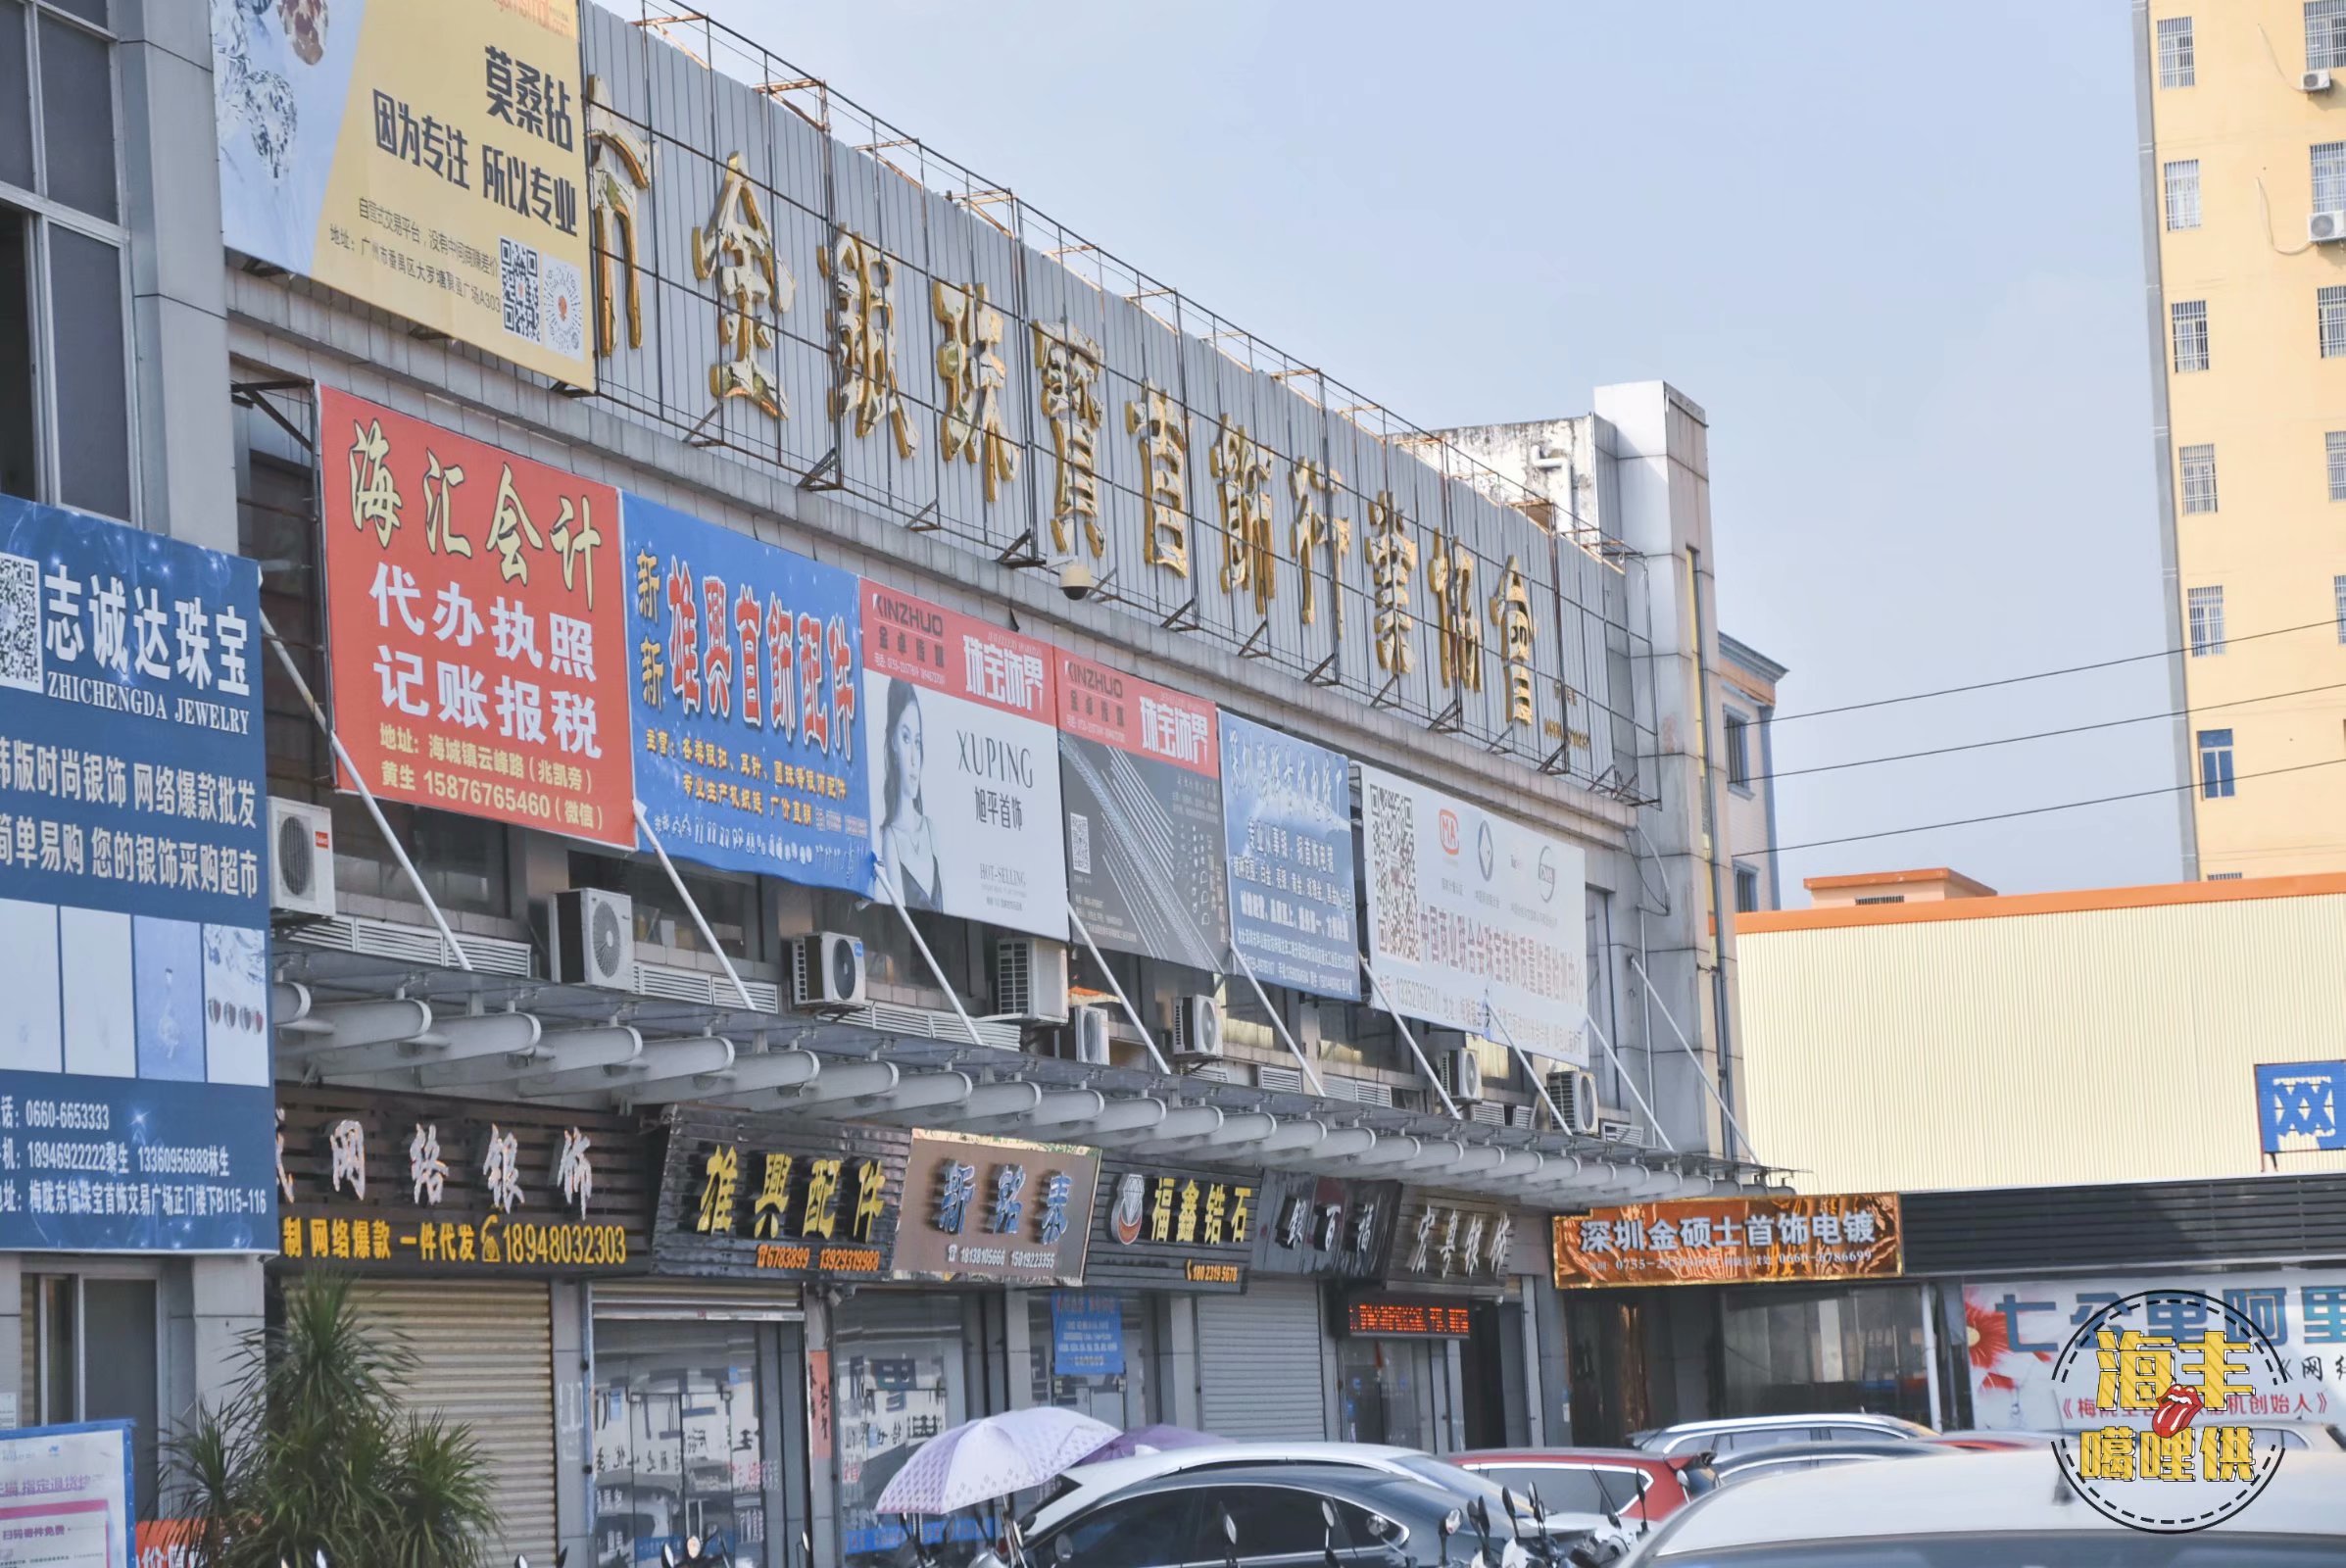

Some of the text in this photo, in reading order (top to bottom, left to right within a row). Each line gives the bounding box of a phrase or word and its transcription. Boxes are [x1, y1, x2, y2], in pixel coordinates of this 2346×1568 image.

[485, 45, 573, 153] 莫桑钻
[372, 88, 578, 237] 因为专注 所以专业
[348, 418, 602, 612] 海汇会计
[44, 564, 250, 696] 志诚达珠宝
[368, 561, 597, 682] 代办执照
[47, 670, 250, 735] ZHICHENGDA JEWELRY
[373, 644, 602, 759] 记账报税
[381, 760, 416, 792] 黄生
[957, 728, 1034, 789] XUPING
[134, 762, 257, 829] 网络爆款批发
[974, 785, 1022, 832] 旭平首饰
[91, 826, 259, 899] 您的银饰采购超市
[0, 1096, 110, 1131] 话：0660-6653333
[0, 1141, 129, 1174] 机：18946922222黎生
[275, 1108, 593, 1221] 网络银饰
[310, 1218, 391, 1259] 网络爆款
[399, 1222, 475, 1262] 一件代发
[503, 1222, 627, 1264] 18948032303
[1580, 1210, 1877, 1252] 深圳金硕士首饰电镀
